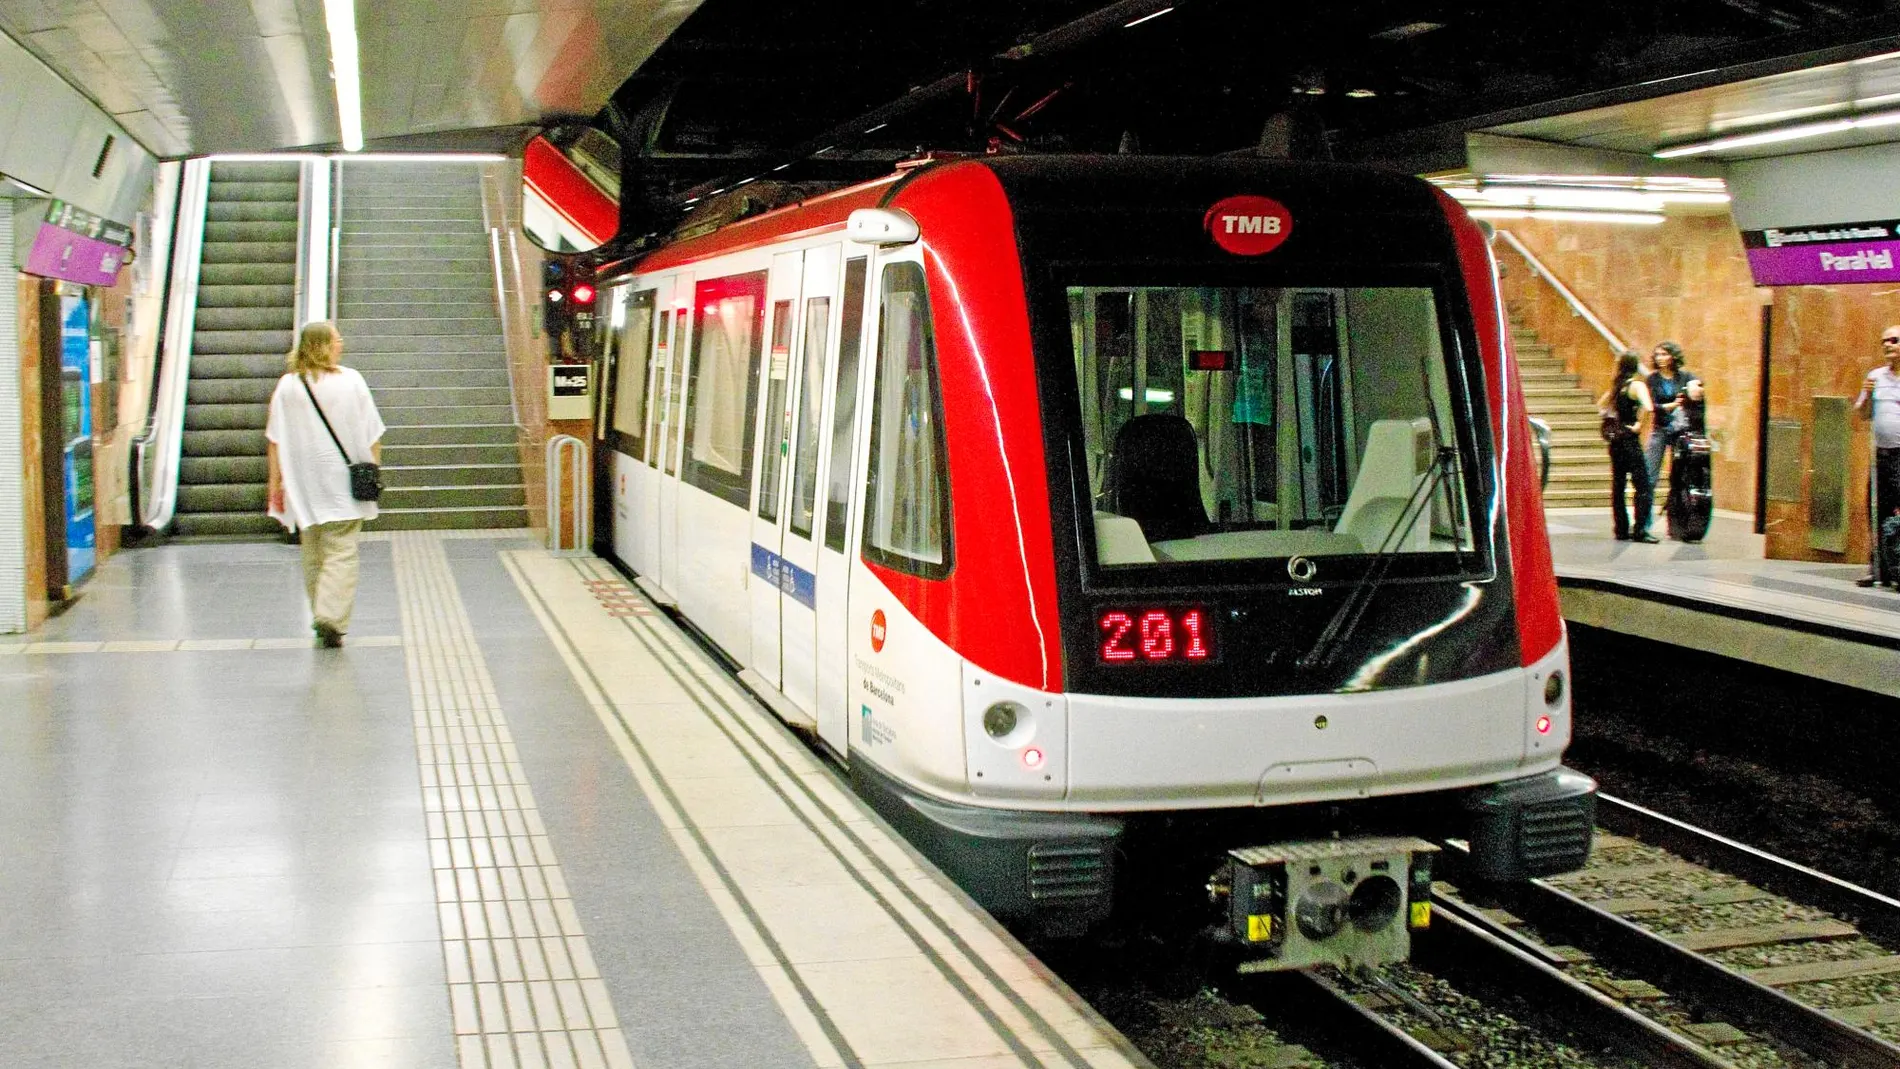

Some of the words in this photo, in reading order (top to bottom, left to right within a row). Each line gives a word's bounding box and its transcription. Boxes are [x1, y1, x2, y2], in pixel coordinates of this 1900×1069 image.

[1222, 215, 1281, 235] TMB
[1103, 612, 1206, 660] 201
[869, 680, 895, 706] Barcelona
